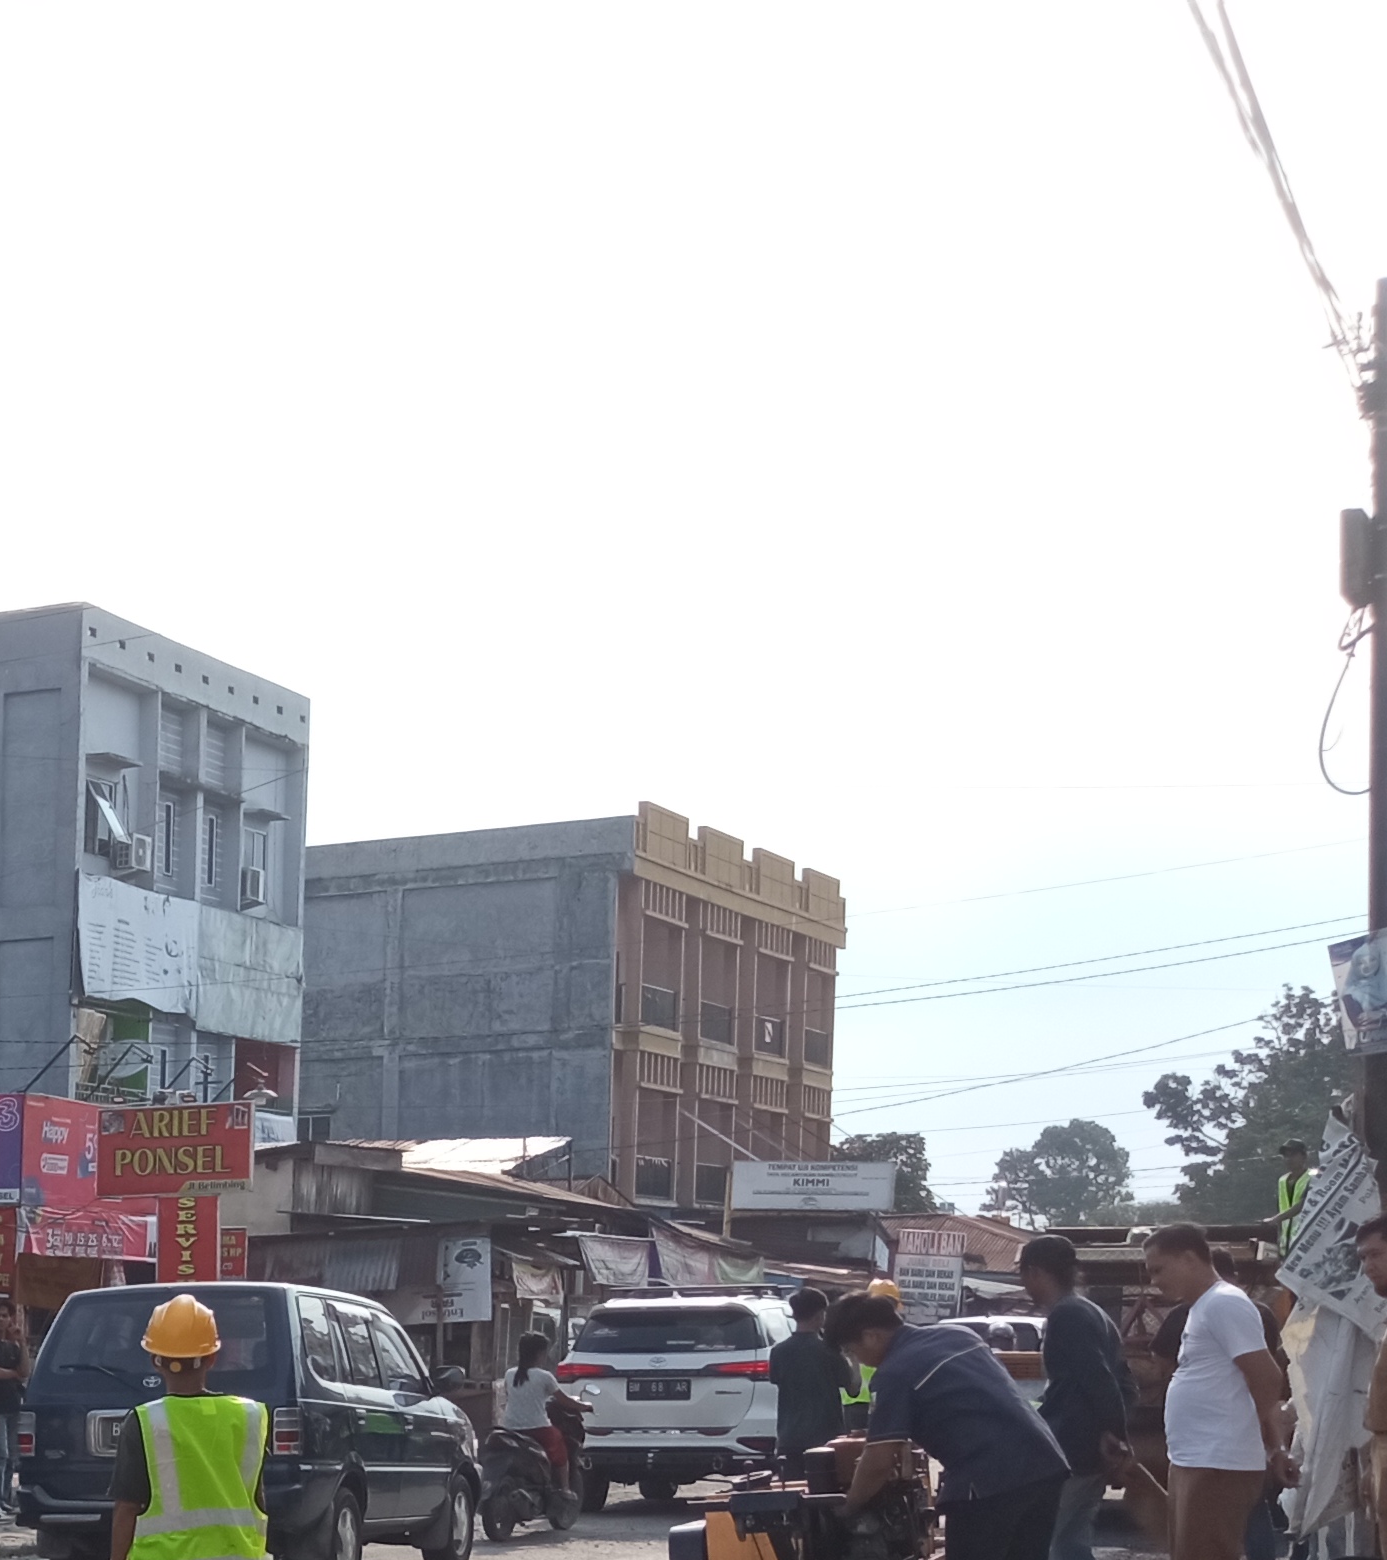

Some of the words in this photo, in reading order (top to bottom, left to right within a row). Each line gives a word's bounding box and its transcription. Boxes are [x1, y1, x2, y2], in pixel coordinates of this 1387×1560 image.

[42, 1121, 69, 1144] Happy
[129, 1107, 217, 1138] ARIEF
[115, 1145, 231, 1177] PONSEL
[793, 1178, 830, 1187] KIMMI
[1315, 1169, 1344, 1199] Room
[940, 1233, 966, 1257] BAN
[1284, 1252, 1302, 1274] New
[1297, 1228, 1323, 1256] Menu
[1325, 1189, 1352, 1222] Ayam
